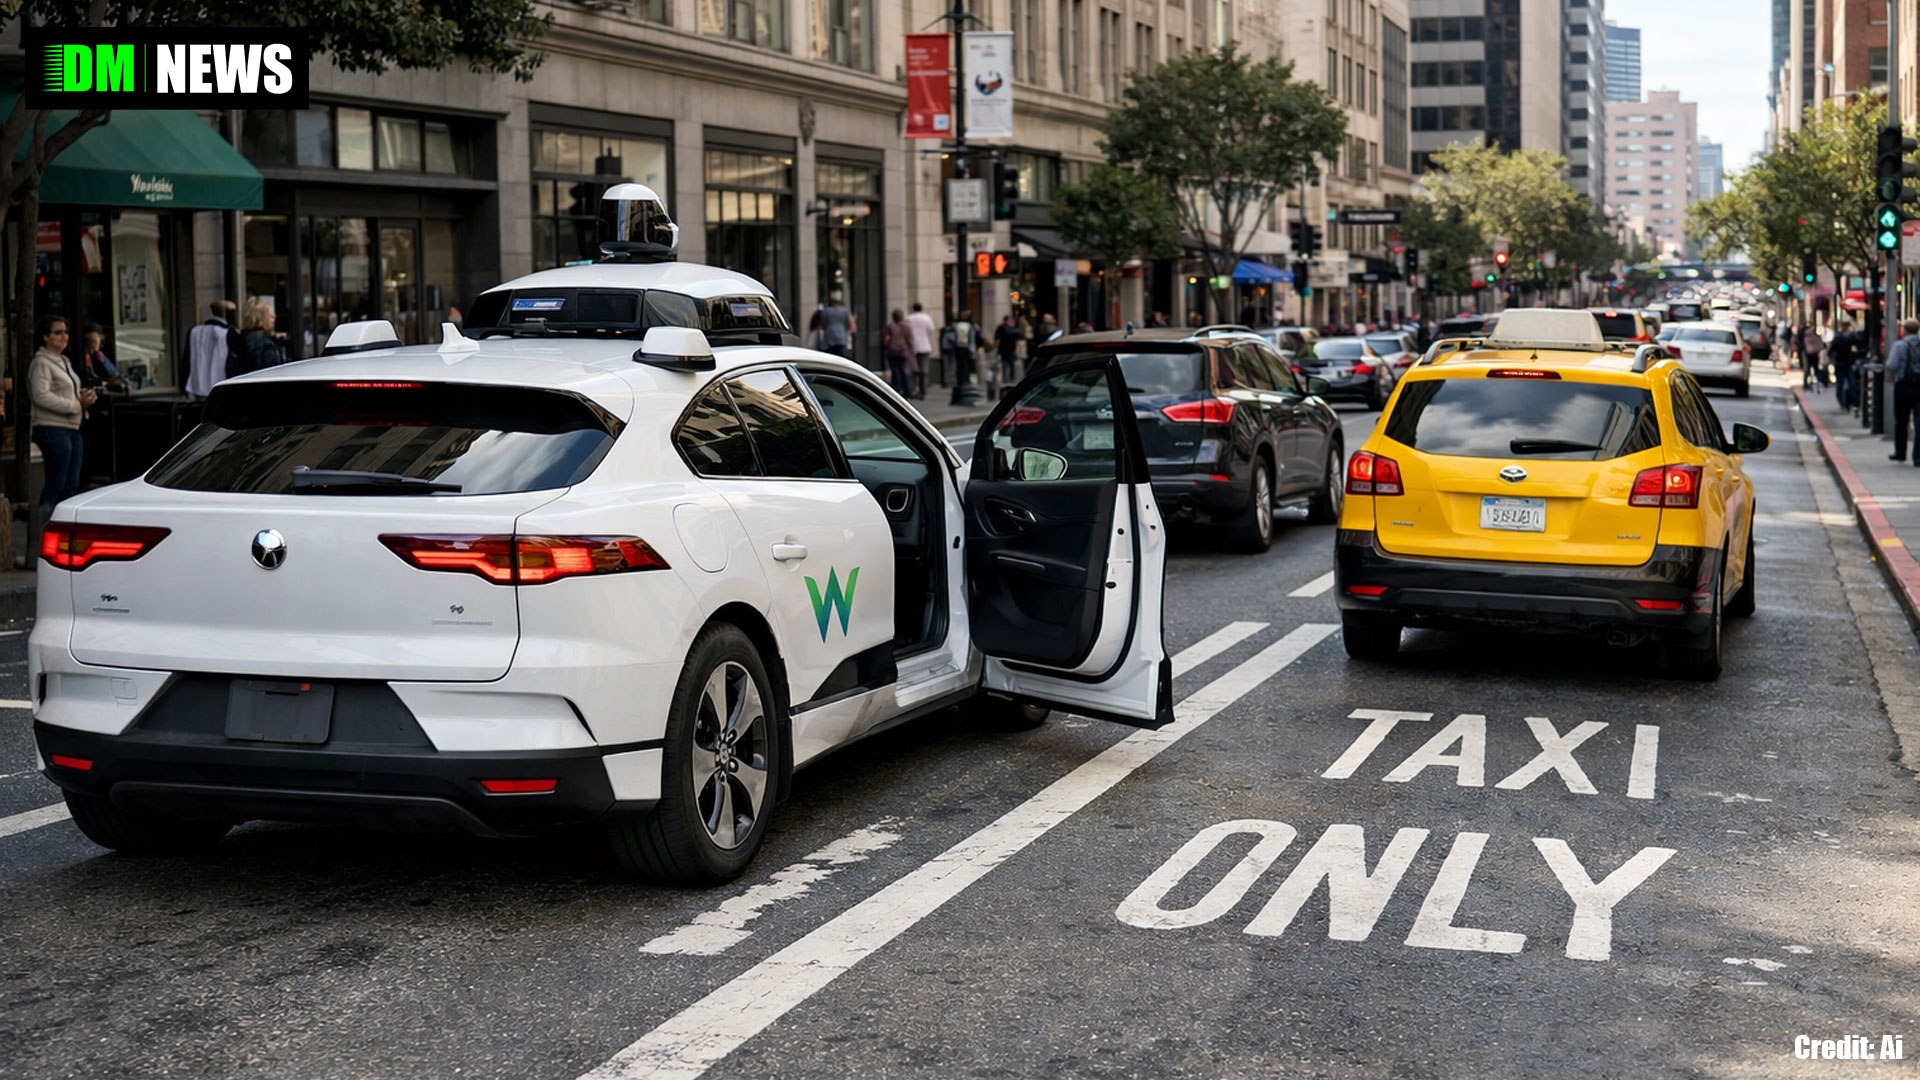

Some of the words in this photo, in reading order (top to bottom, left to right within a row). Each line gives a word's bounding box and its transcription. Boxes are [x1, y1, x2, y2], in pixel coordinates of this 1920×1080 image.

[803, 565, 861, 644] W
[1321, 707, 1661, 800] TAXI
[1114, 818, 1678, 962] ONLY
